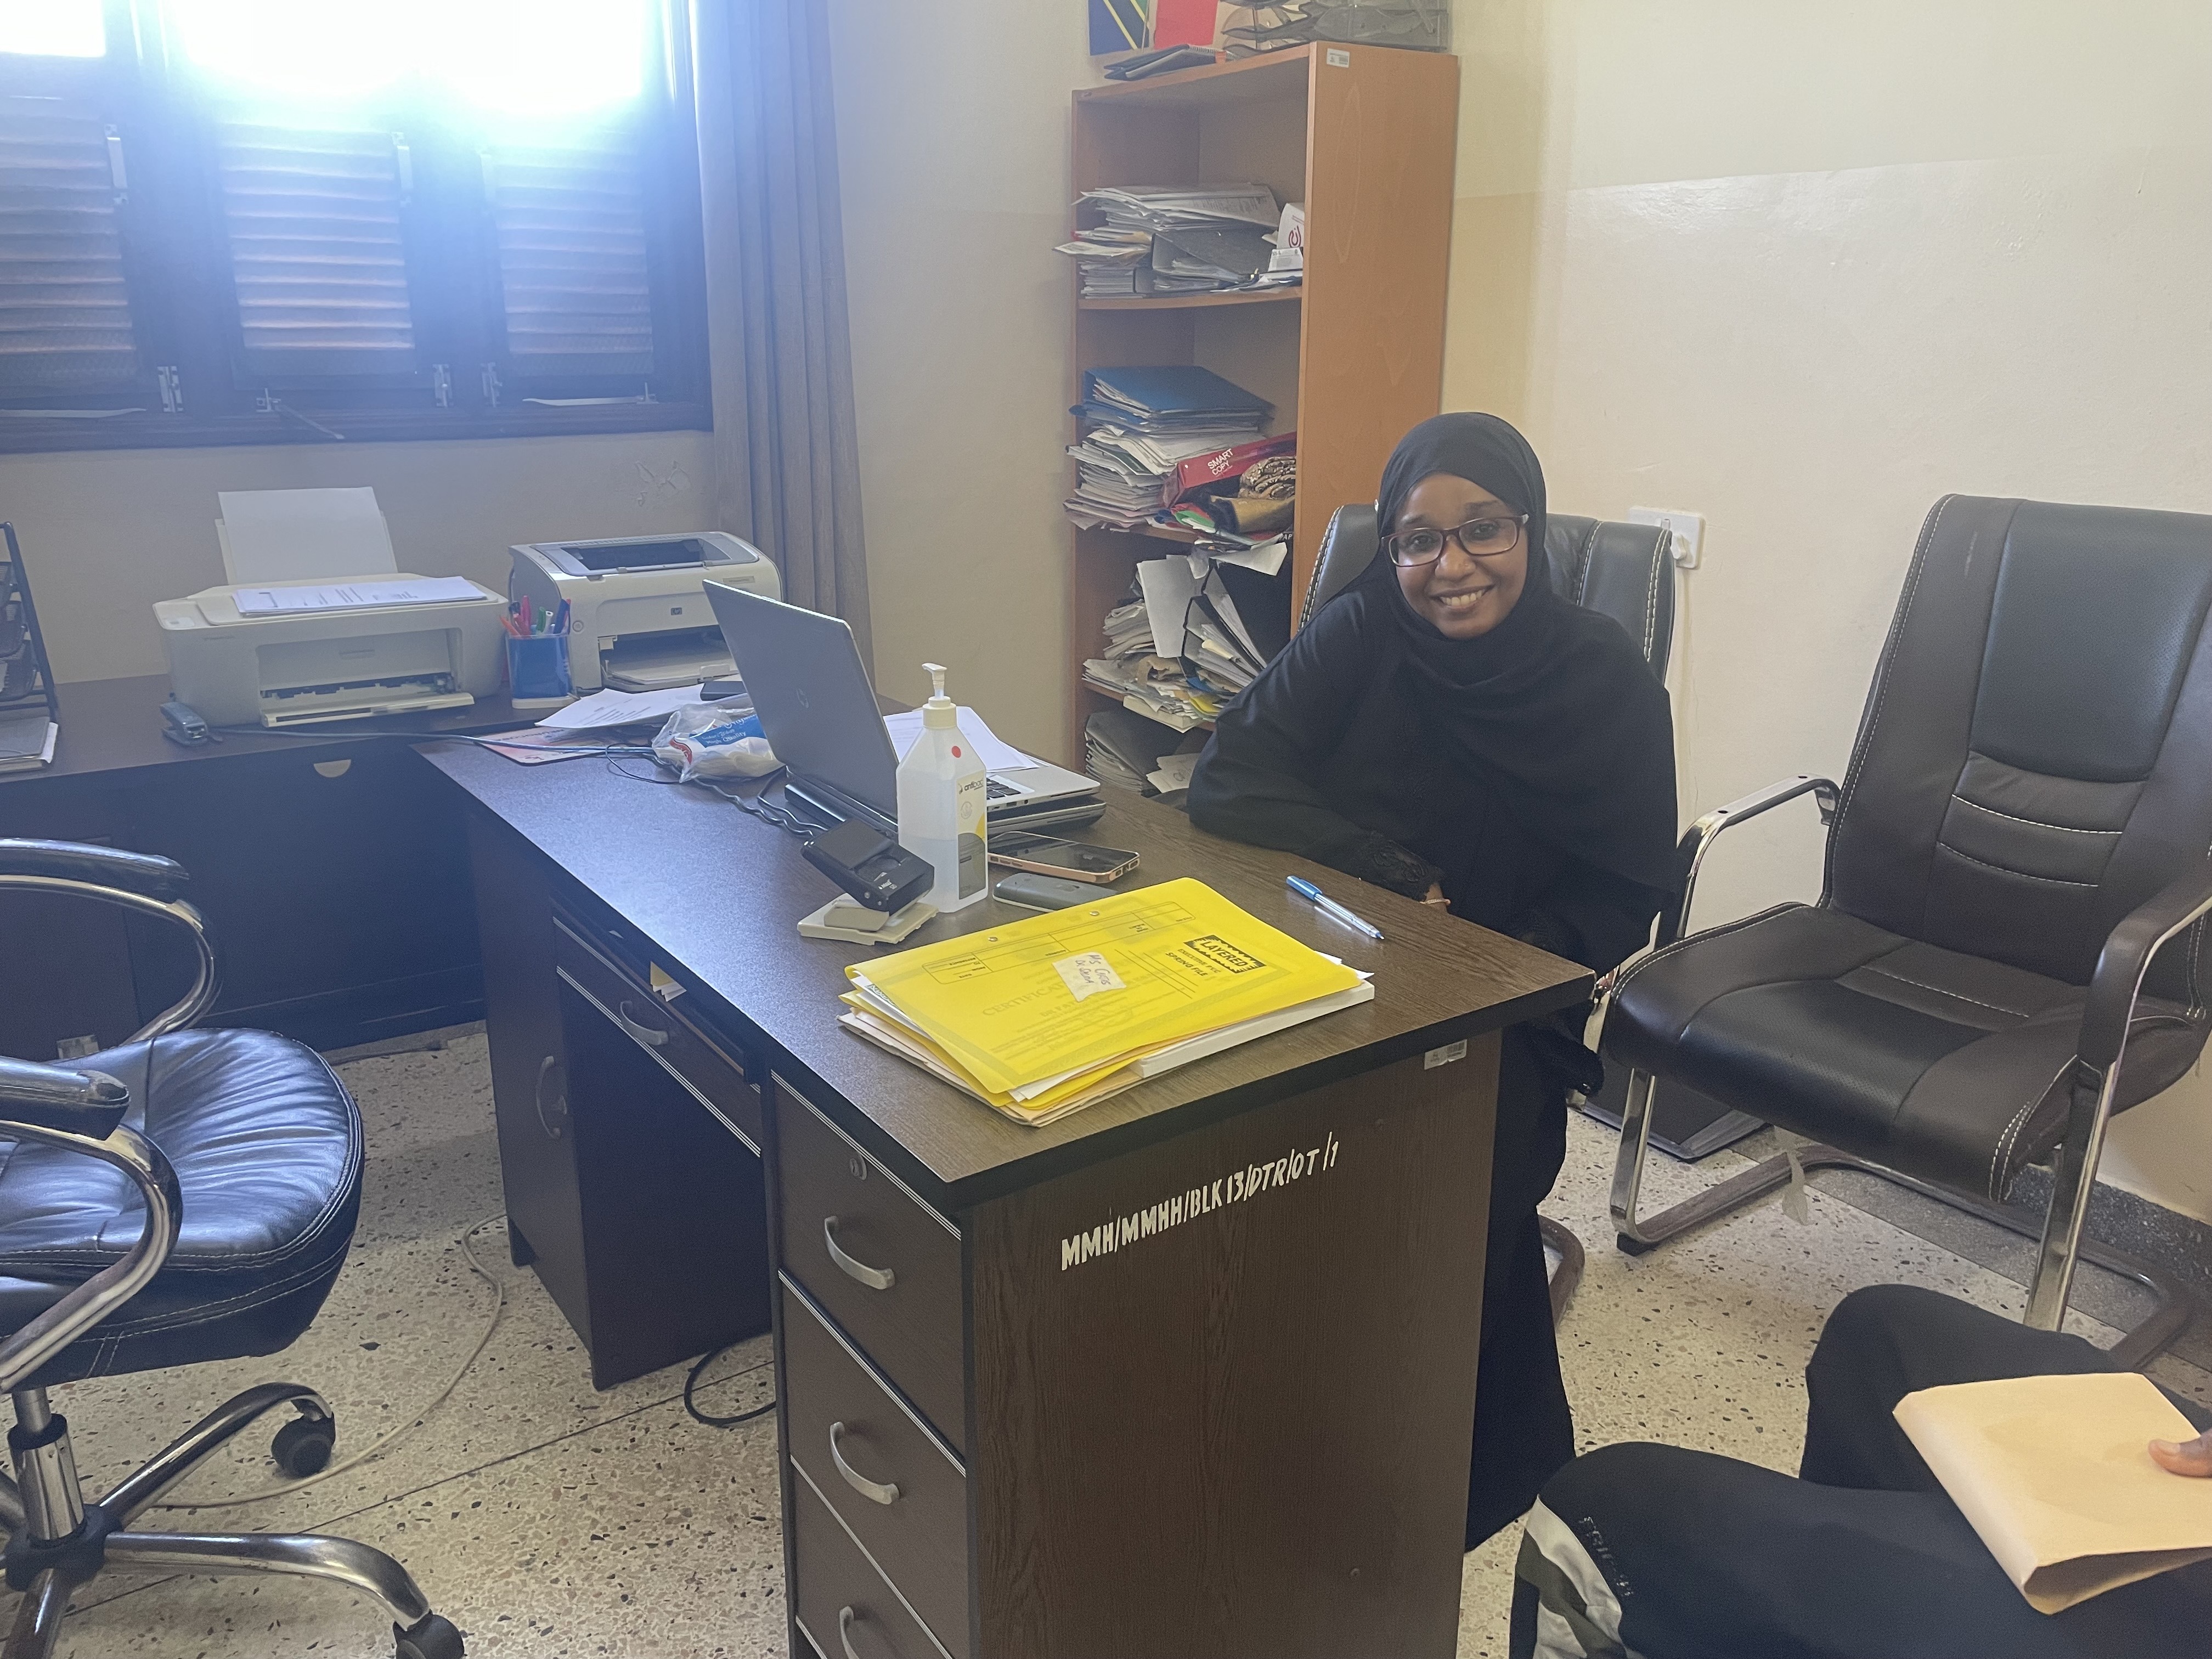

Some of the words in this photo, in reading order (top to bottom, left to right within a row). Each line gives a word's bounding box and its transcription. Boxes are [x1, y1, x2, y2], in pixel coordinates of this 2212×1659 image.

[1207, 448, 1233, 469] SMART
[1212, 460, 1229, 475] COPY
[1165, 952, 1194, 968] SPRING
[1192, 967, 1209, 977] FILE
[1200, 940, 1249, 967] LAYERED
